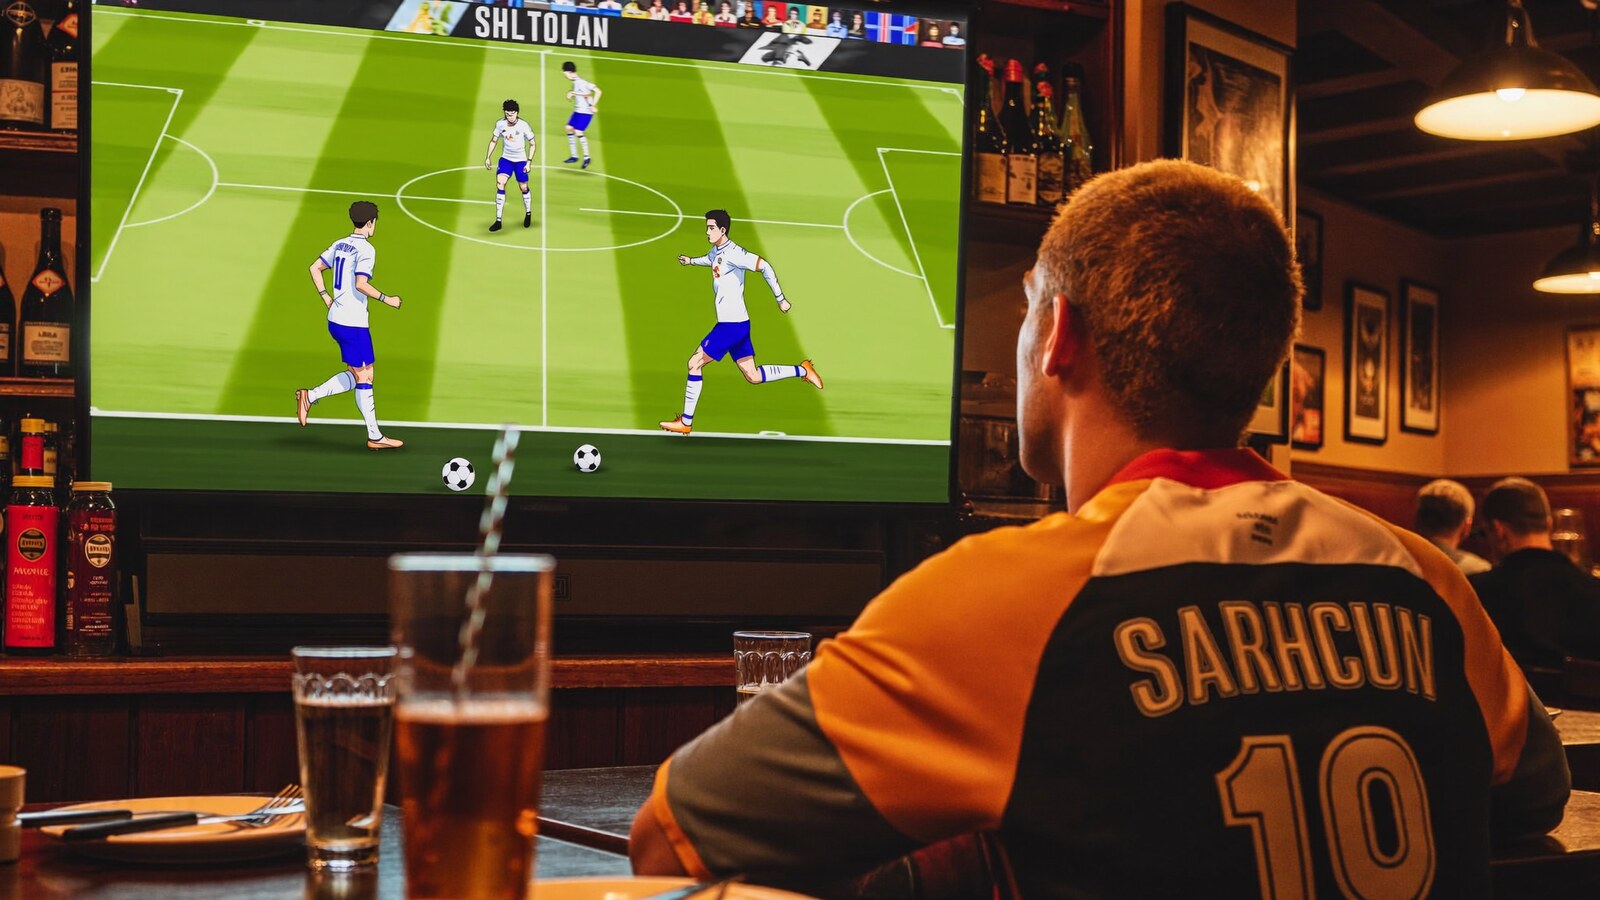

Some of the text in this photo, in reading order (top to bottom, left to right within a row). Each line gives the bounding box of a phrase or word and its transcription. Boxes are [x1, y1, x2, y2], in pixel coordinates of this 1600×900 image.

[475, 6, 608, 48] SHLTOLAN
[1113, 601, 1436, 718] SARHCUN
[1214, 725, 1436, 900] 10
